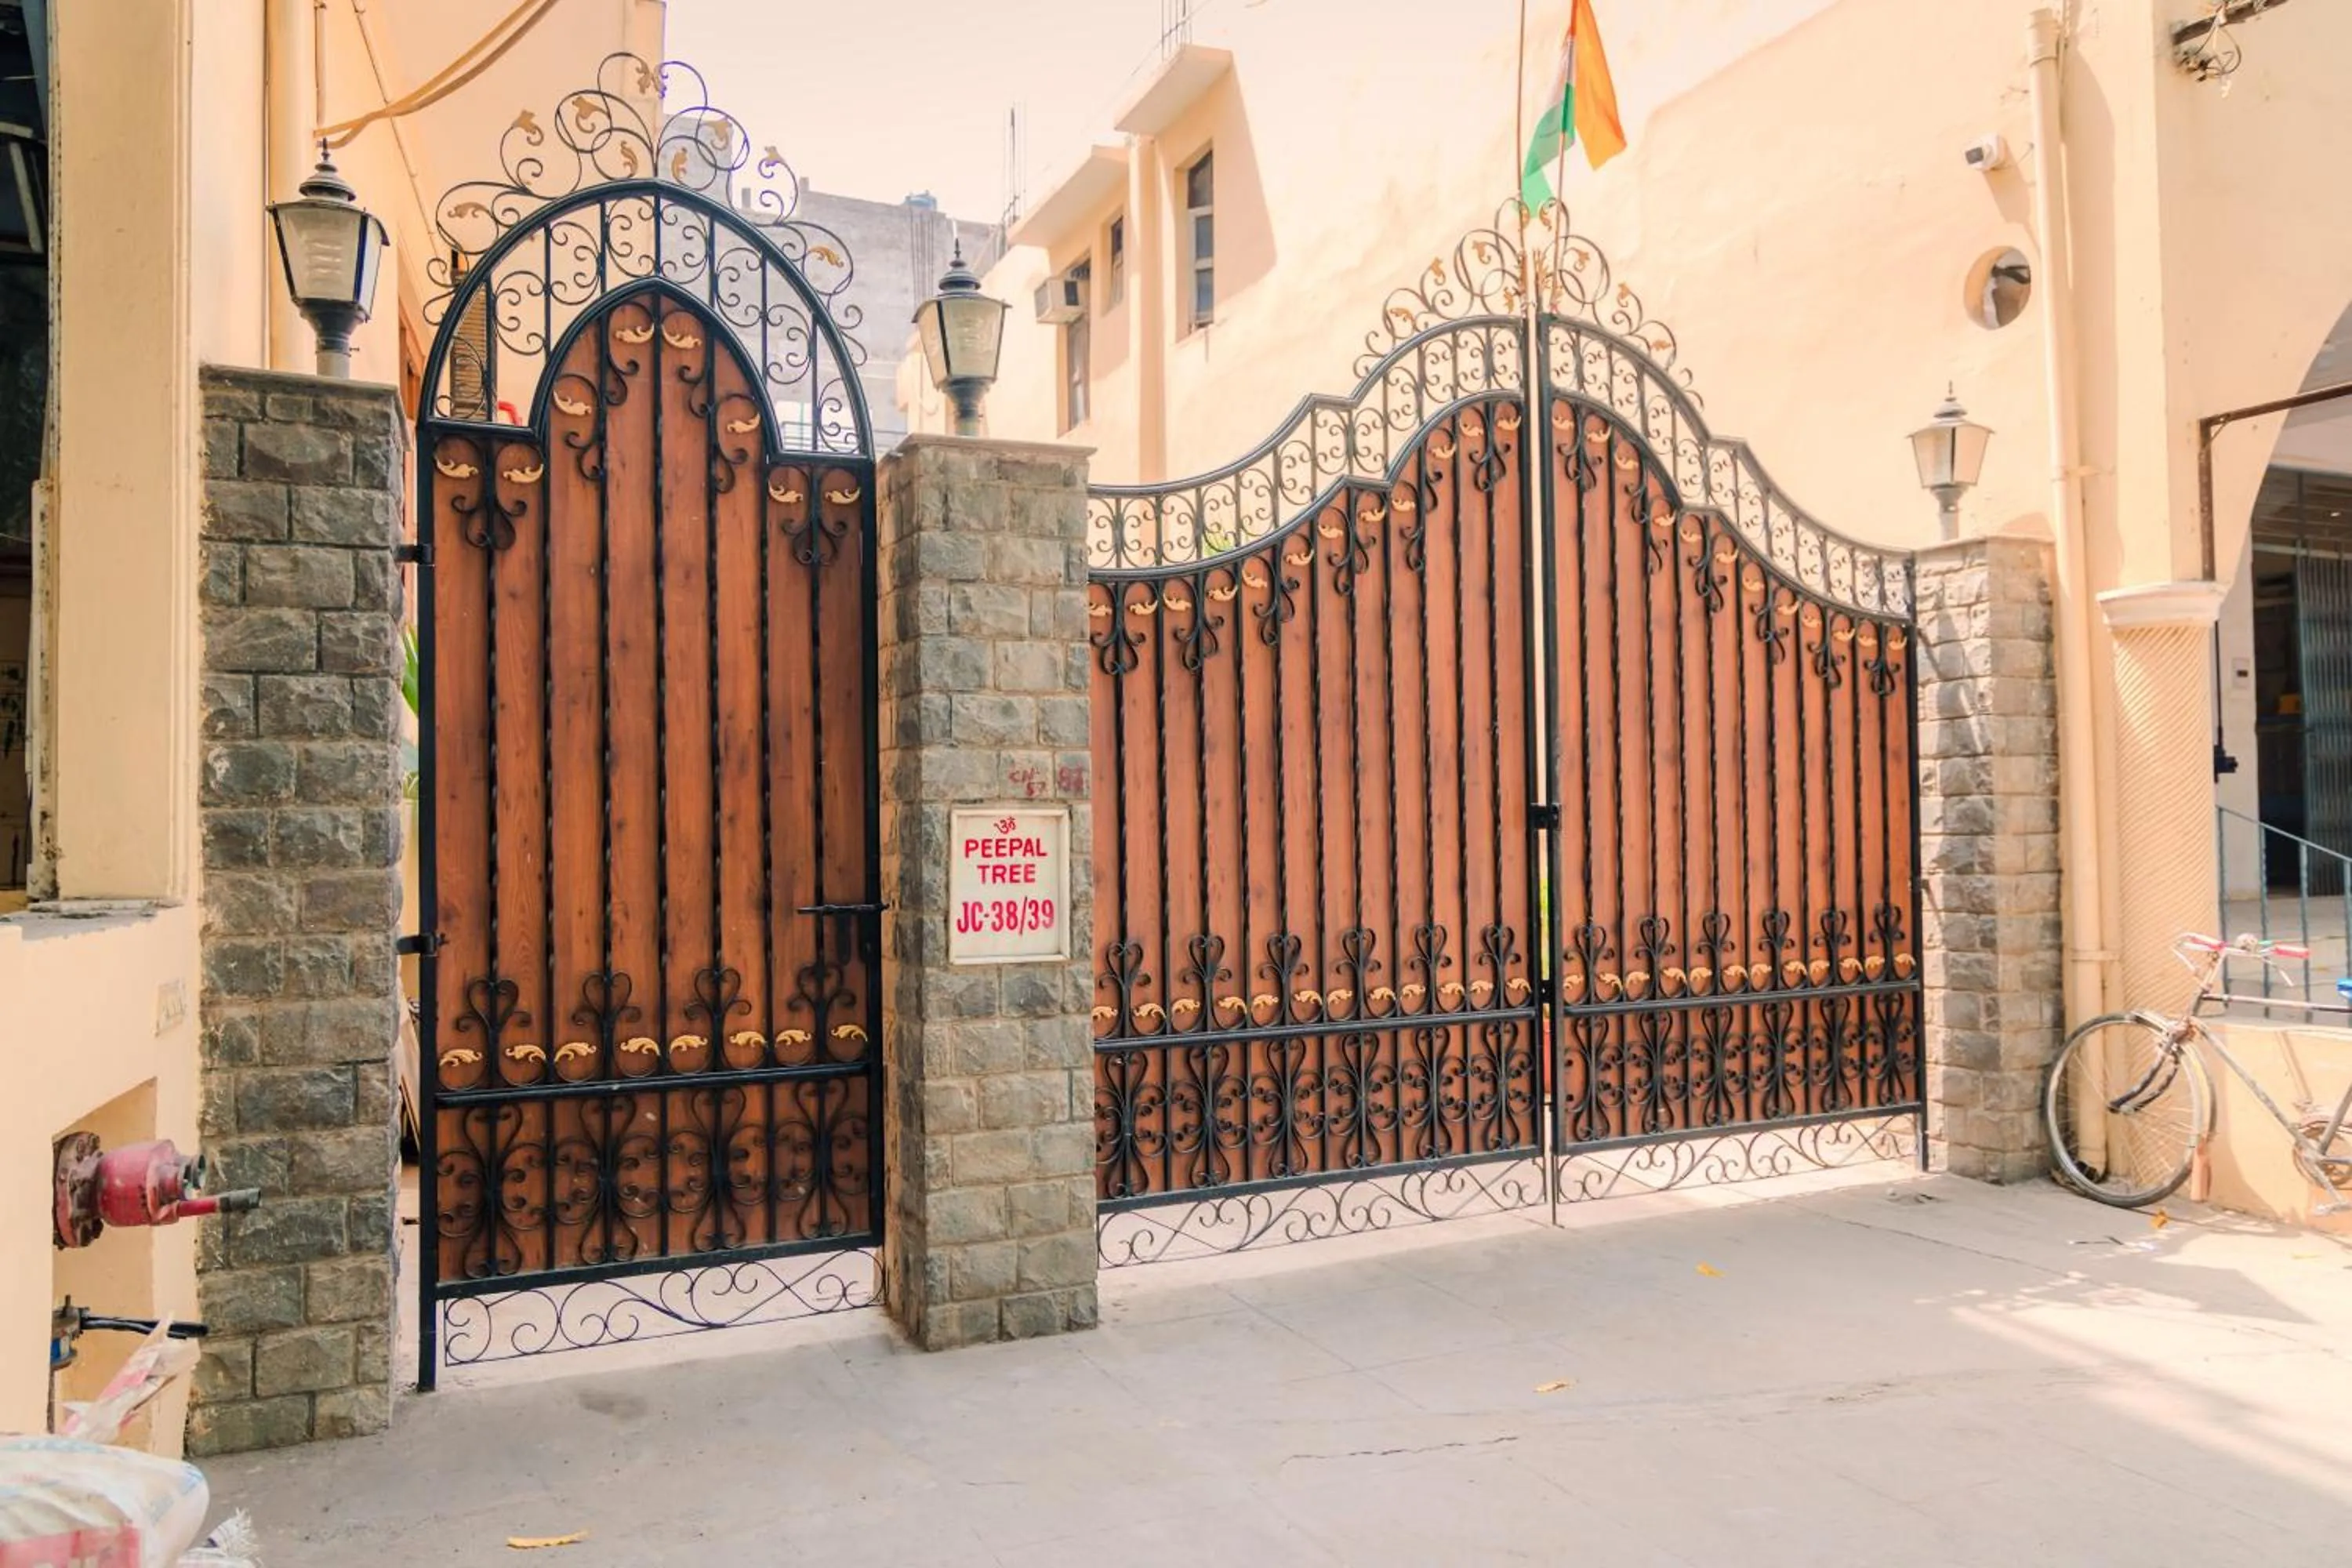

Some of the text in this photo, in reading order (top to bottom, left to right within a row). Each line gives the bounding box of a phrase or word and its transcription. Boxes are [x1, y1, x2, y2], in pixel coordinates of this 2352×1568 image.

[964, 838, 1047, 858] PEEPAL
[977, 863, 1036, 884] TREE
[956, 896, 1054, 936] JC-38/39
